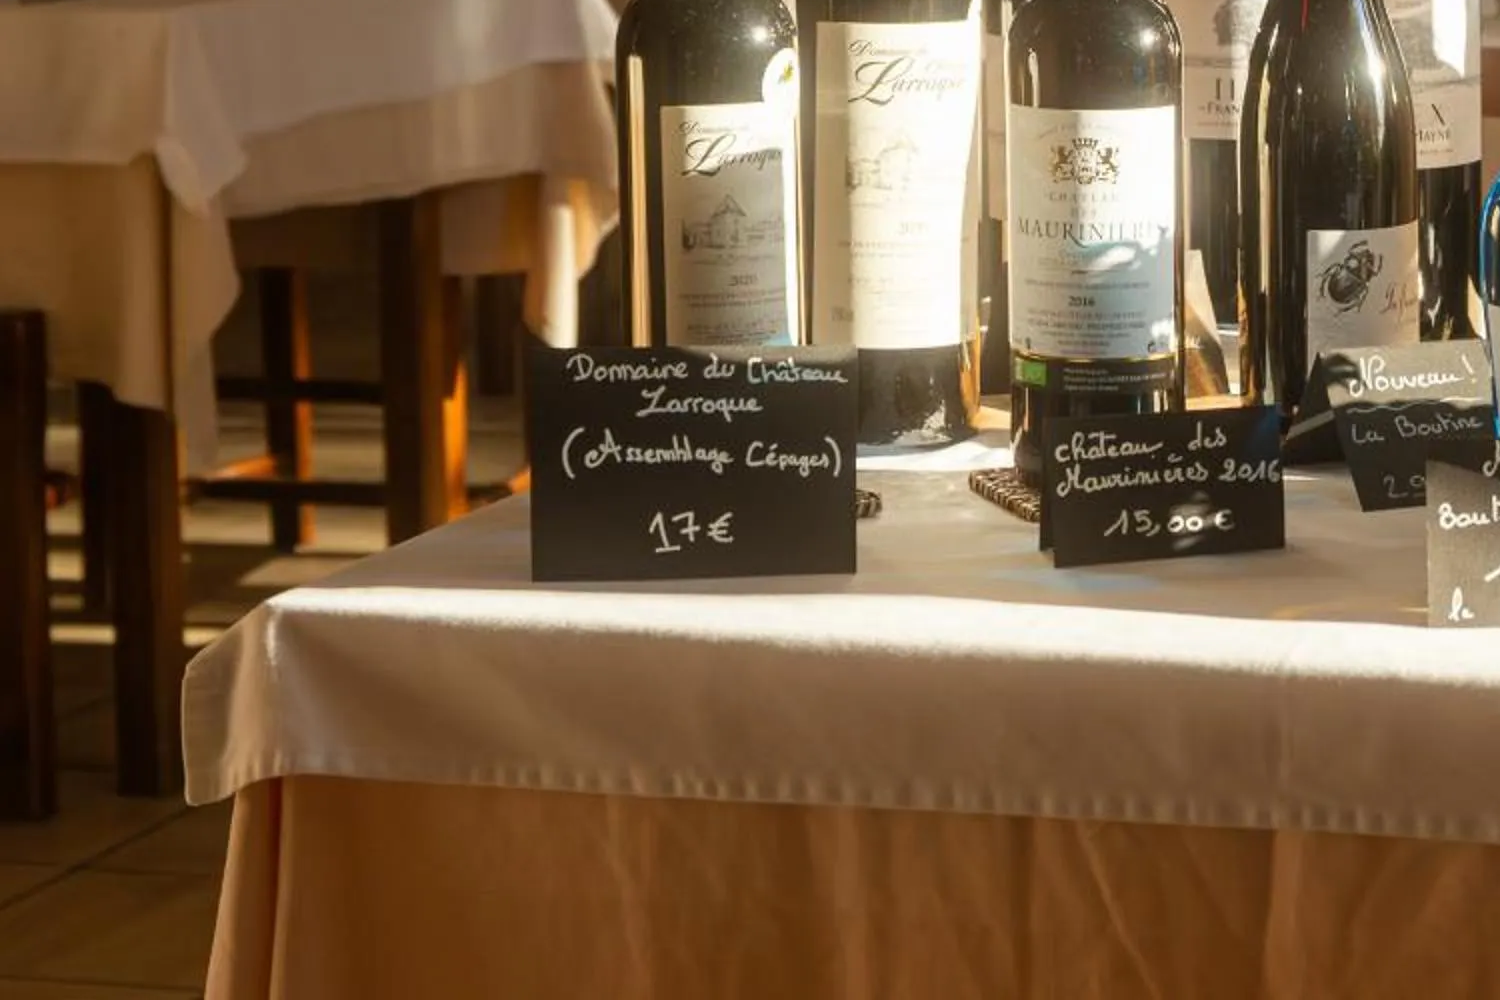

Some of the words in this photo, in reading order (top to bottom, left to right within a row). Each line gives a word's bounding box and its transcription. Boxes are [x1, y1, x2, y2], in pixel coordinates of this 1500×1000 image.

[566, 353, 688, 382] Domaine
[703, 353, 735, 379] du
[747, 355, 848, 384] Château
[636, 386, 763, 422] Larroque
[1188, 420, 1228, 450] des
[1218, 458, 1281, 484] 2016
